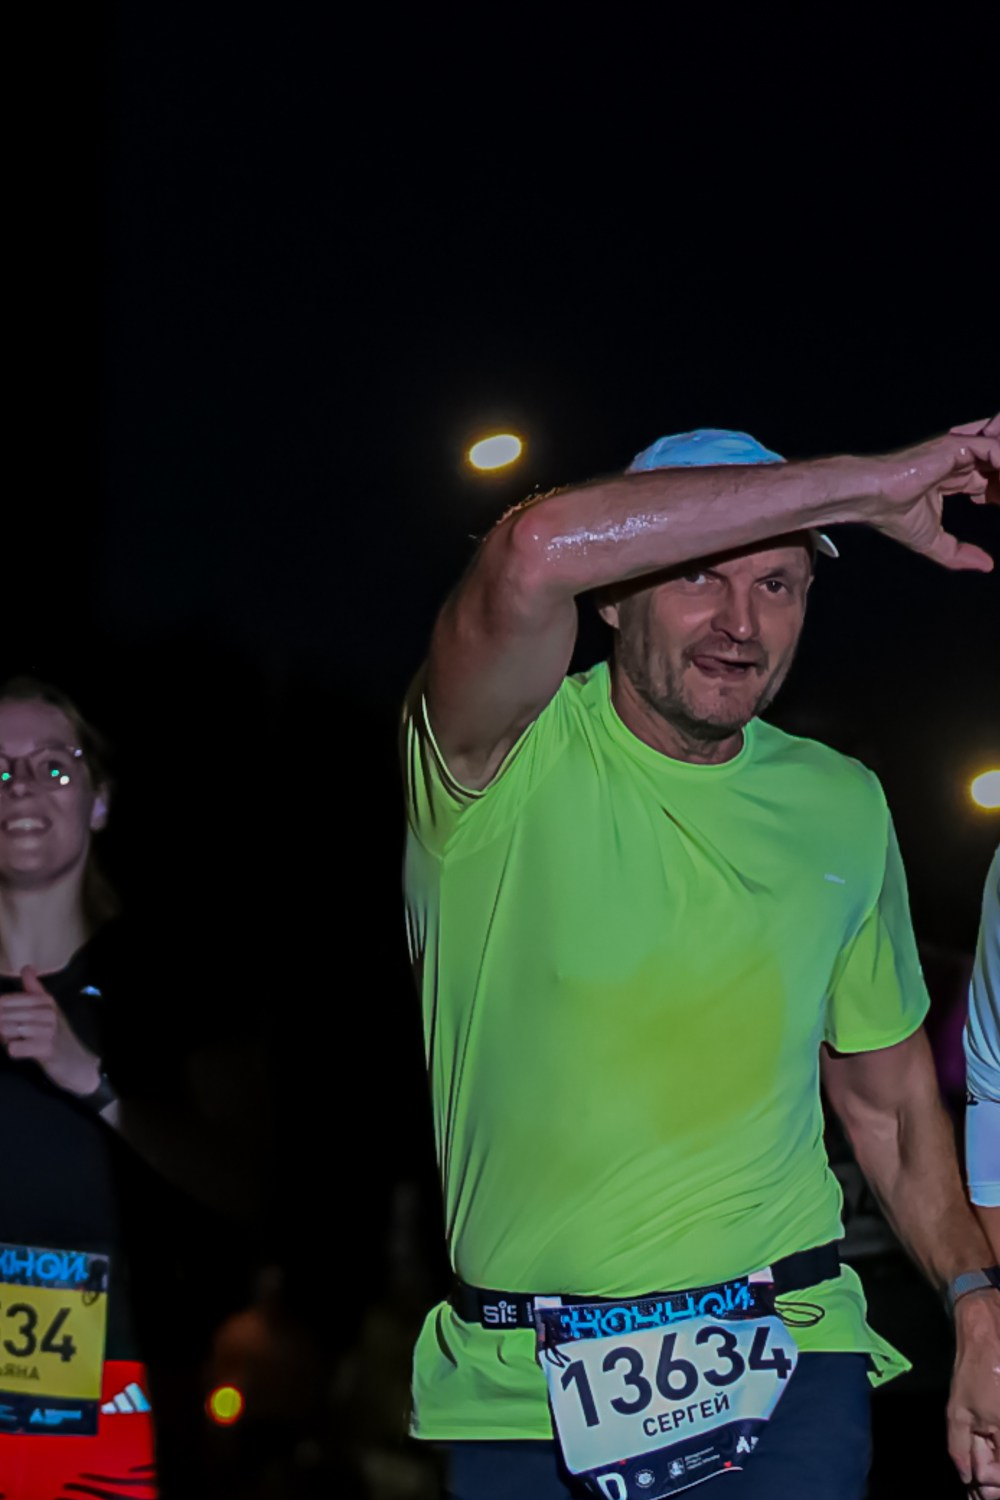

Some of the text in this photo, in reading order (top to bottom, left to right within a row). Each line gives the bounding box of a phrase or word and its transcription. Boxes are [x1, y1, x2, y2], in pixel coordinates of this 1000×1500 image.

[0, 1302, 76, 1362] 34
[561, 1326, 792, 1428] 13634
[642, 1392, 731, 1438] СЕРГЕЙ
